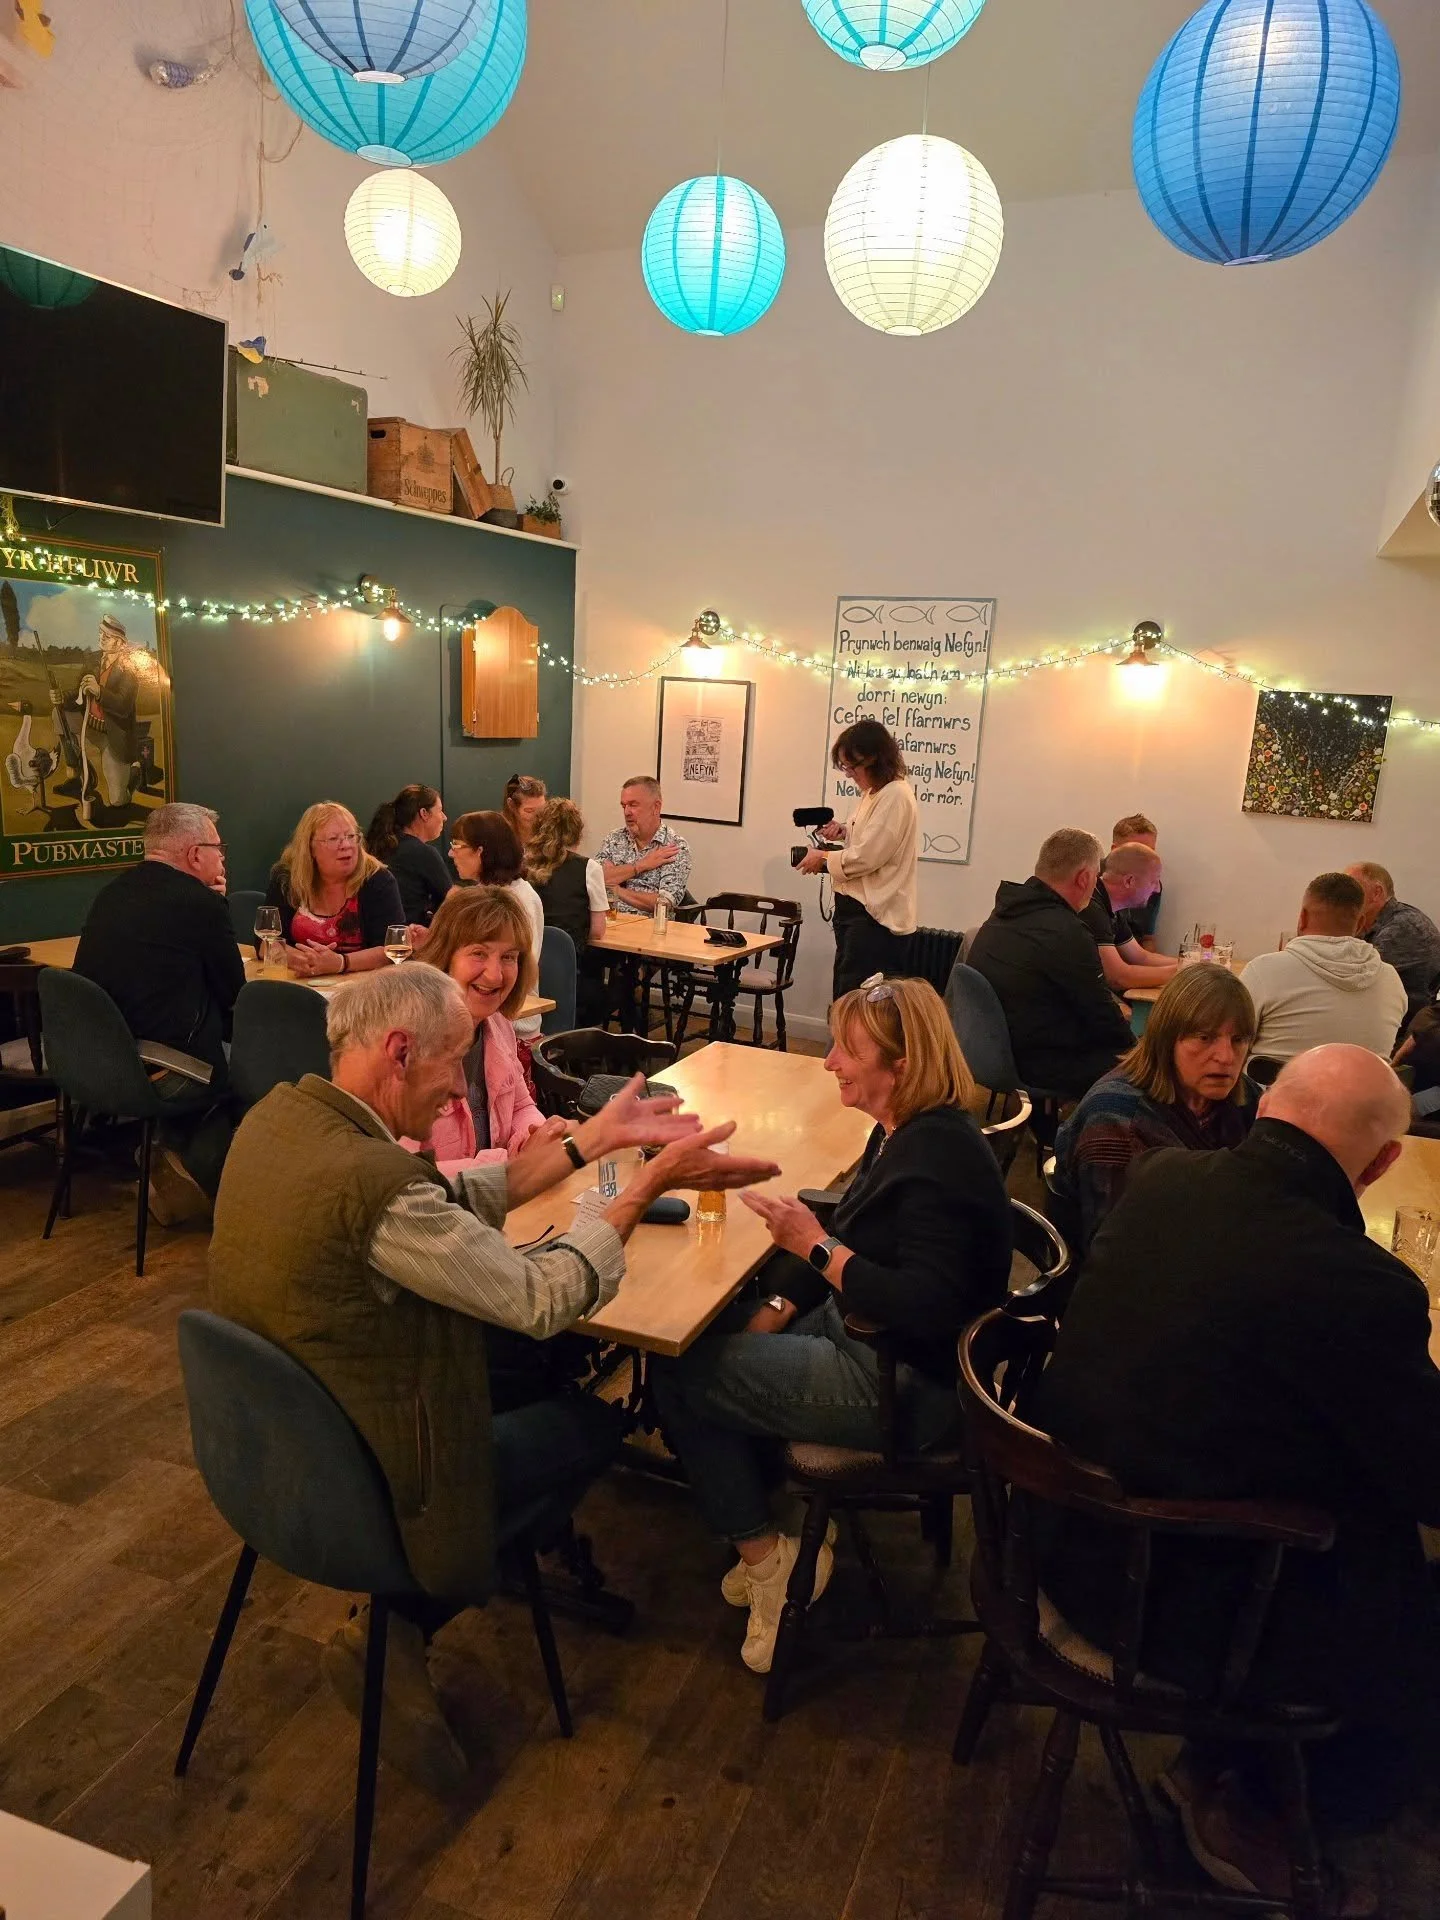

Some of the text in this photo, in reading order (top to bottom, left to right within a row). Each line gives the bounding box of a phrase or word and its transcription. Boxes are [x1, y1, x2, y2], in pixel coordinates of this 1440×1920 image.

[404, 478, 447, 504] Schweppes
[1, 547, 139, 583] YR HELIWR
[839, 630, 988, 658] Prynwch benwaig Nefyn!
[857, 683, 895, 703] dorri
[882, 706, 900, 727] fel
[905, 707, 971, 731] ffarmwrs
[689, 763, 715, 776] NEFYN
[934, 760, 976, 786] Nefyn!
[11, 838, 145, 866] PUBMASTE
